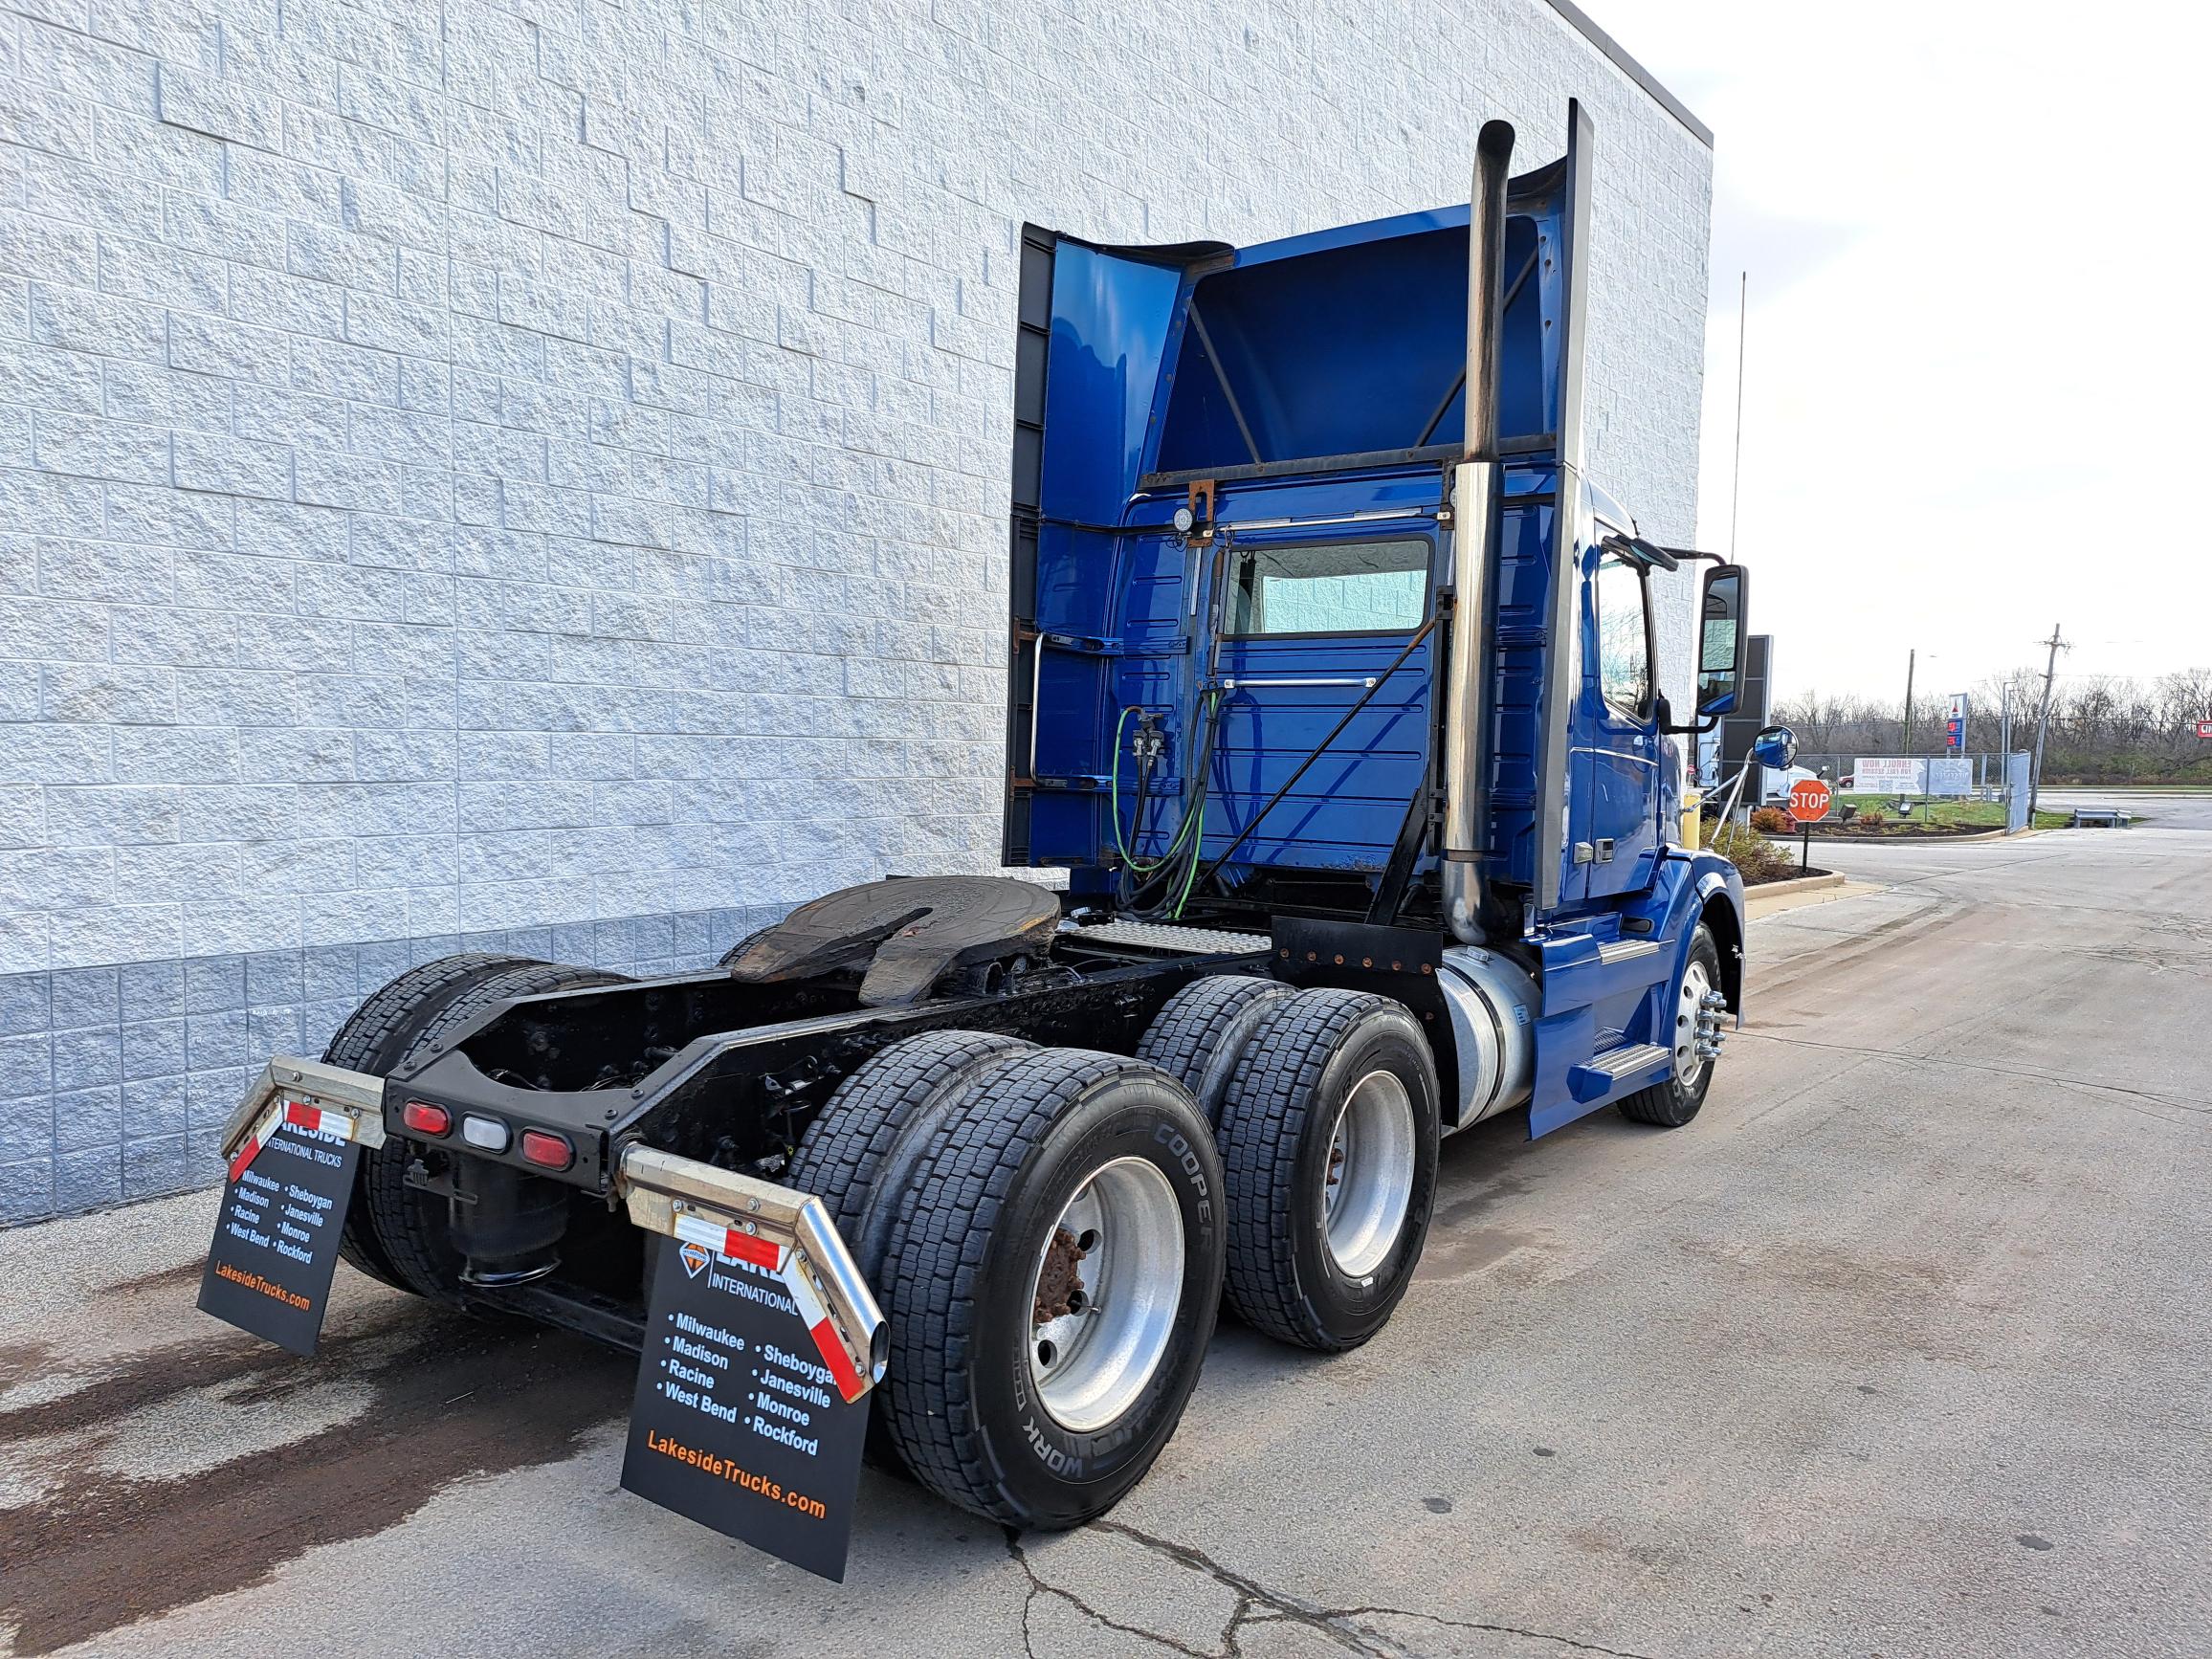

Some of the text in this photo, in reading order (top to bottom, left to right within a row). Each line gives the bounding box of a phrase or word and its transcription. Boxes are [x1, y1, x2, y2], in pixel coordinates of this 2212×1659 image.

[1789, 792, 1829, 809] STOP
[266, 1137, 343, 1168] NTERNATIONAL TRUCKS
[238, 1186, 270, 1208] Madison
[242, 1169, 280, 1192] Milwaukee
[289, 1184, 333, 1210] Sheboygan
[234, 1205, 260, 1225] Racine
[285, 1203, 323, 1228] Janesville
[231, 1222, 270, 1248] West Bend
[281, 1221, 310, 1243] Monroe
[276, 1239, 313, 1264] Rockford
[215, 1259, 310, 1311] LakesideTrucks.com
[712, 1272, 799, 1316] INTERNATIONAL
[675, 1312, 745, 1351] Milwaukee
[672, 1335, 729, 1370] Madison
[763, 1344, 837, 1385] Sheboyga
[668, 1359, 715, 1389] Racine
[760, 1368, 831, 1408] Janesville
[665, 1381, 738, 1424] West Bend
[756, 1391, 810, 1427] Monroe
[753, 1415, 818, 1456] Rockford
[1022, 1416, 1084, 1479] WORK
[648, 1429, 826, 1519] LakesideTrucks.com
